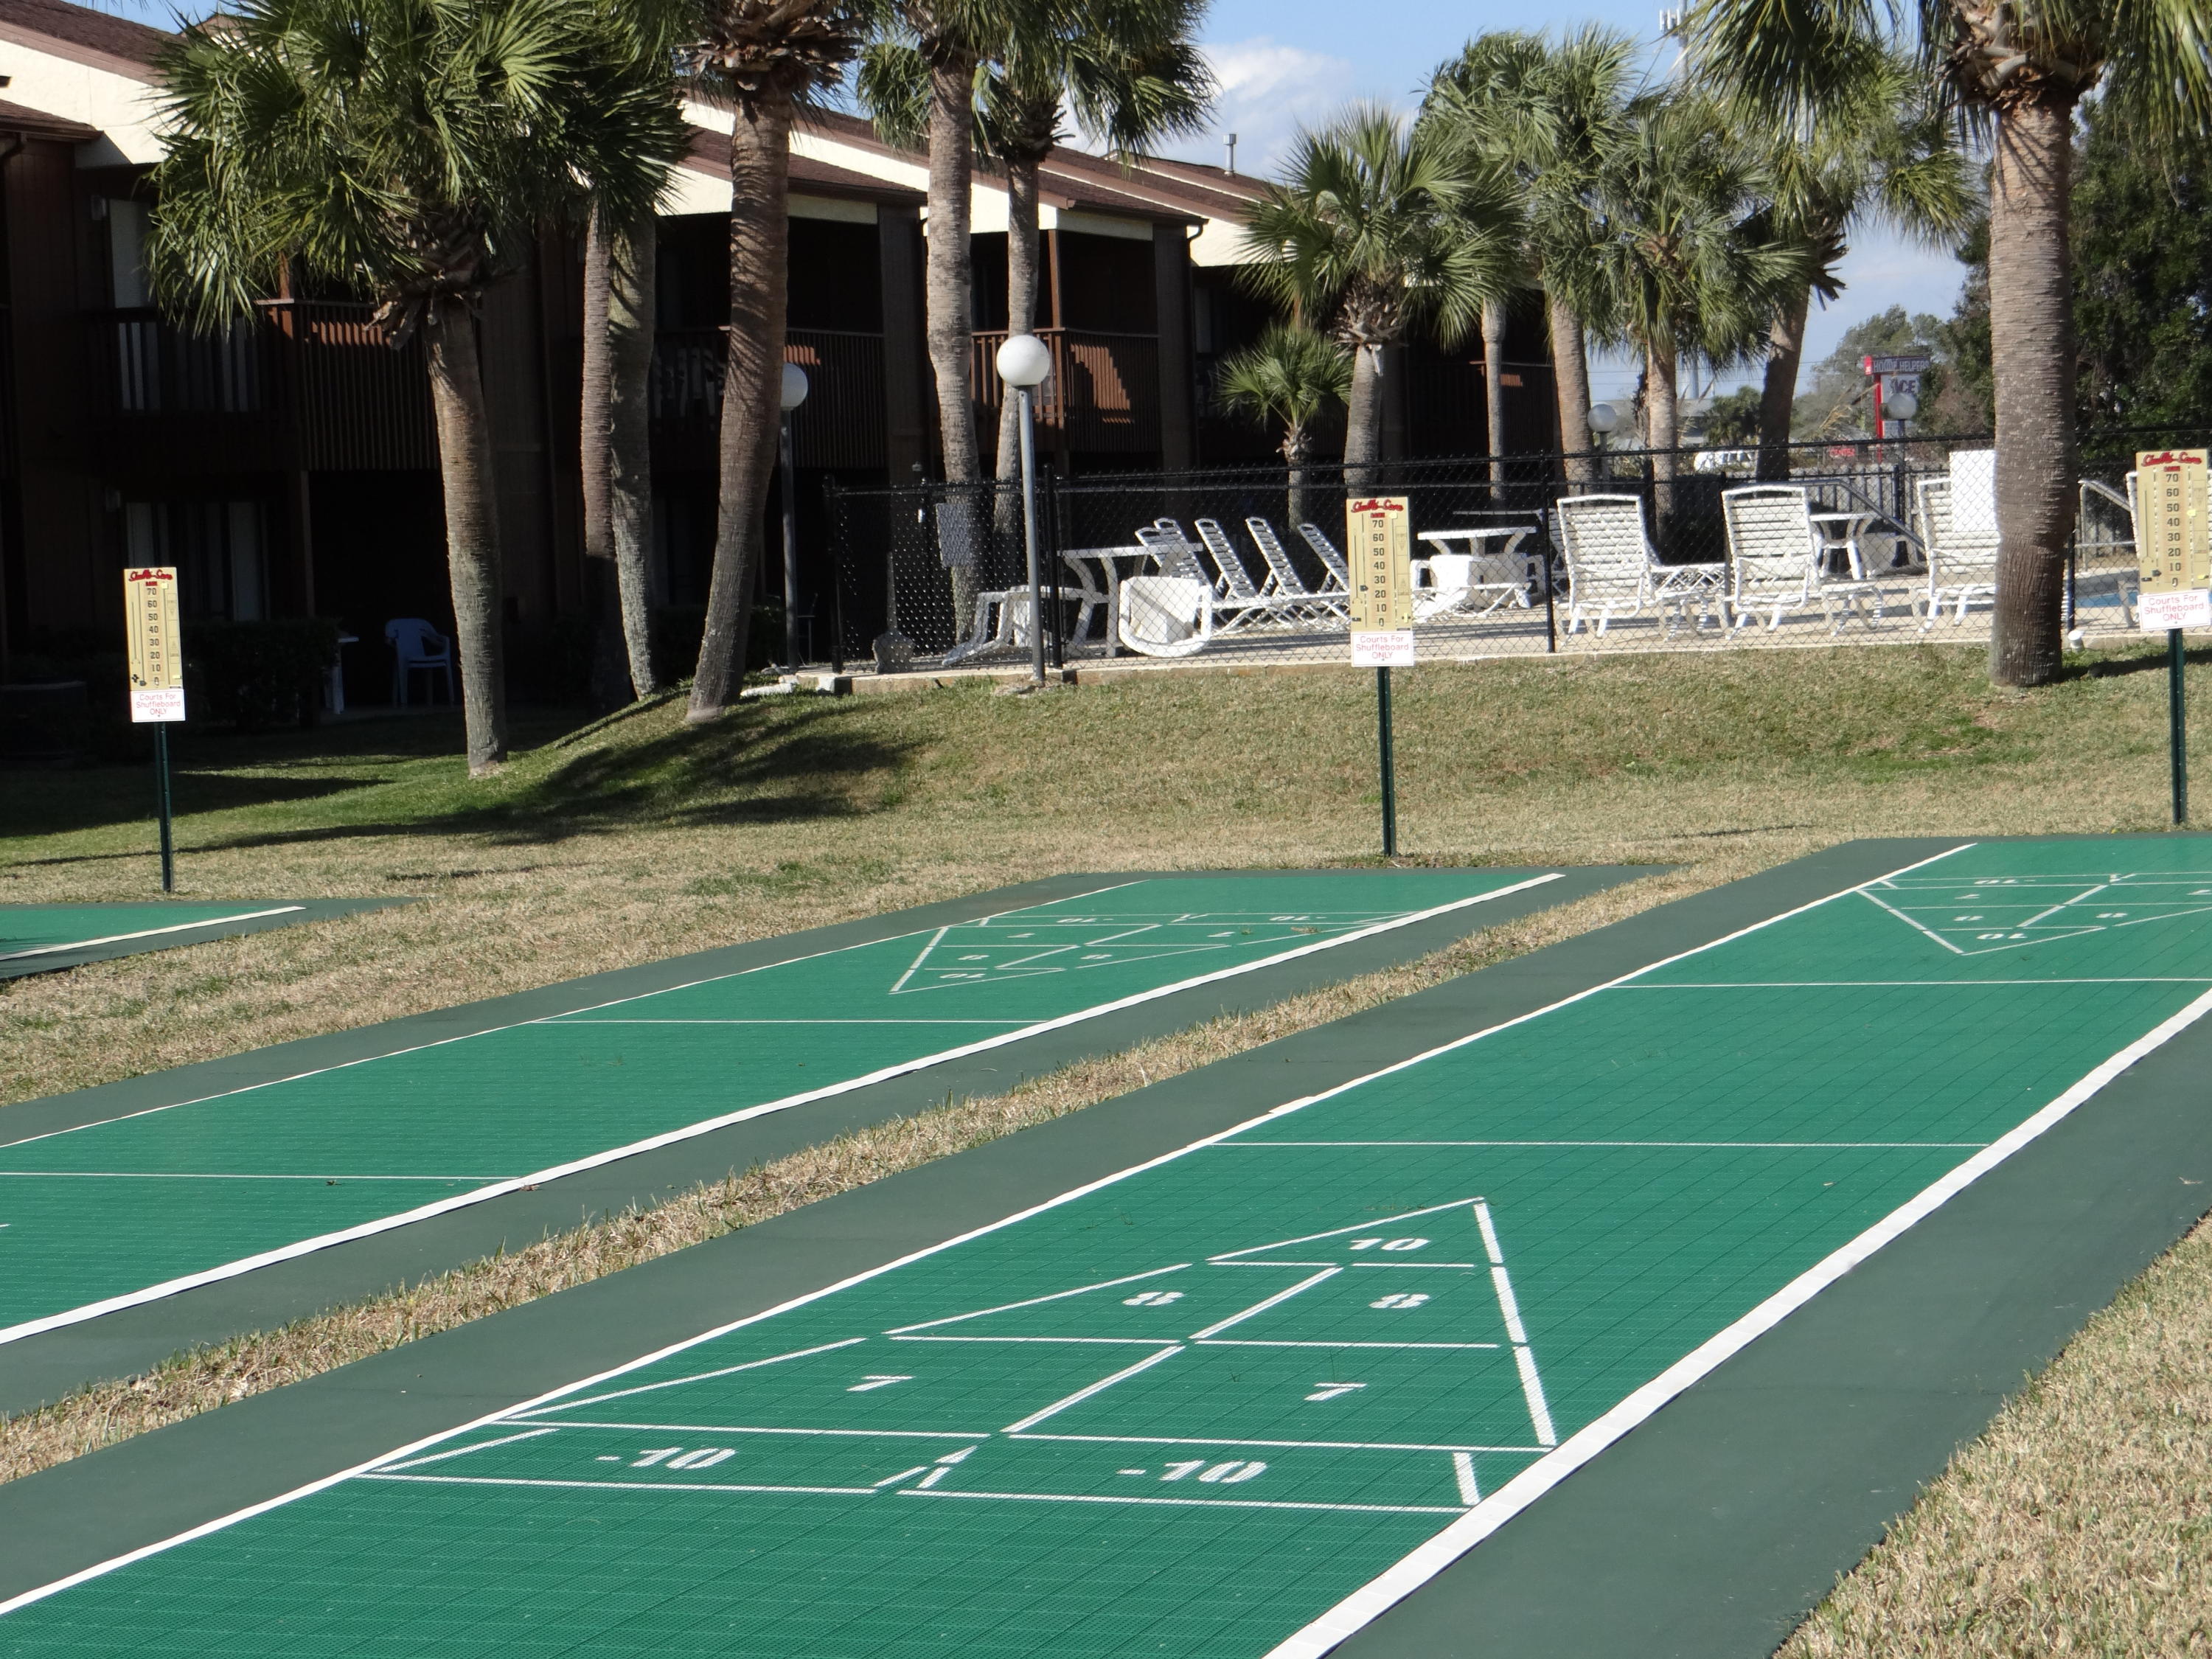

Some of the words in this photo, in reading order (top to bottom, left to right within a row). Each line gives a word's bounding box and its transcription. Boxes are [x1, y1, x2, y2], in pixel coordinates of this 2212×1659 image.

[2166, 473, 2178, 482] 70
[2166, 488, 2179, 497] 60
[2166, 503, 2180, 512] 50
[1372, 520, 1383, 528] 70
[2167, 518, 2180, 526] 40
[1373, 534, 1384, 542] 60
[2167, 533, 2180, 542] 30
[1373, 548, 1385, 556] 50
[2168, 548, 2181, 557] 20
[1374, 562, 1385, 570] 40
[2169, 563, 2181, 571] 10
[1374, 576, 1385, 584] 30
[147, 588, 156, 596] 70
[1374, 590, 1386, 598] 20
[2149, 597, 2180, 605] Courts
[1376, 604, 1387, 612] 10
[2144, 602, 2204, 614] Shuffleboard
[2163, 612, 2186, 621] ONLY
[148, 625, 159, 633] 40
[1349, 1238, 1431, 1251] 10
[1122, 1292, 1186, 1307] 8
[1368, 1293, 1431, 1308] 8
[846, 1375, 916, 1391] 7
[1304, 1382, 1368, 1401] 7
[595, 1447, 738, 1469] -10
[1116, 1460, 1268, 1484] -10
